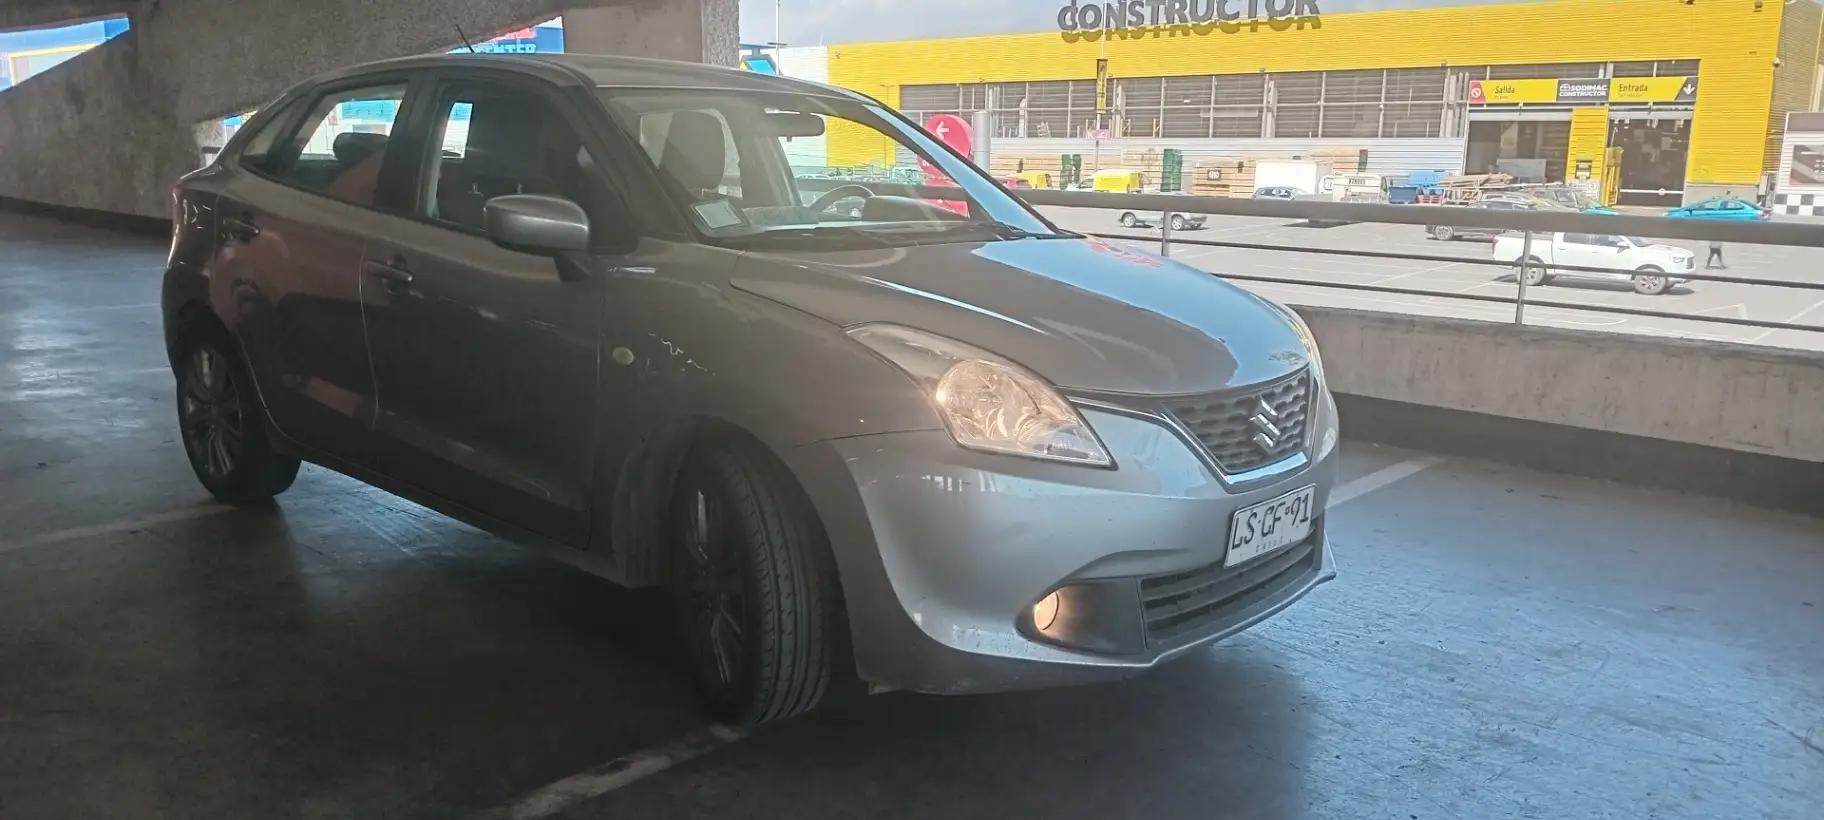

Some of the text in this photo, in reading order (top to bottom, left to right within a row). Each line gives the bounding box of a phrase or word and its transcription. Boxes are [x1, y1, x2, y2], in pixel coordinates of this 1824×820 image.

[1057, 0, 1320, 31] CONSTRUCTOR
[1494, 85, 1515, 94] Salida
[1619, 83, 1648, 92] Entrada
